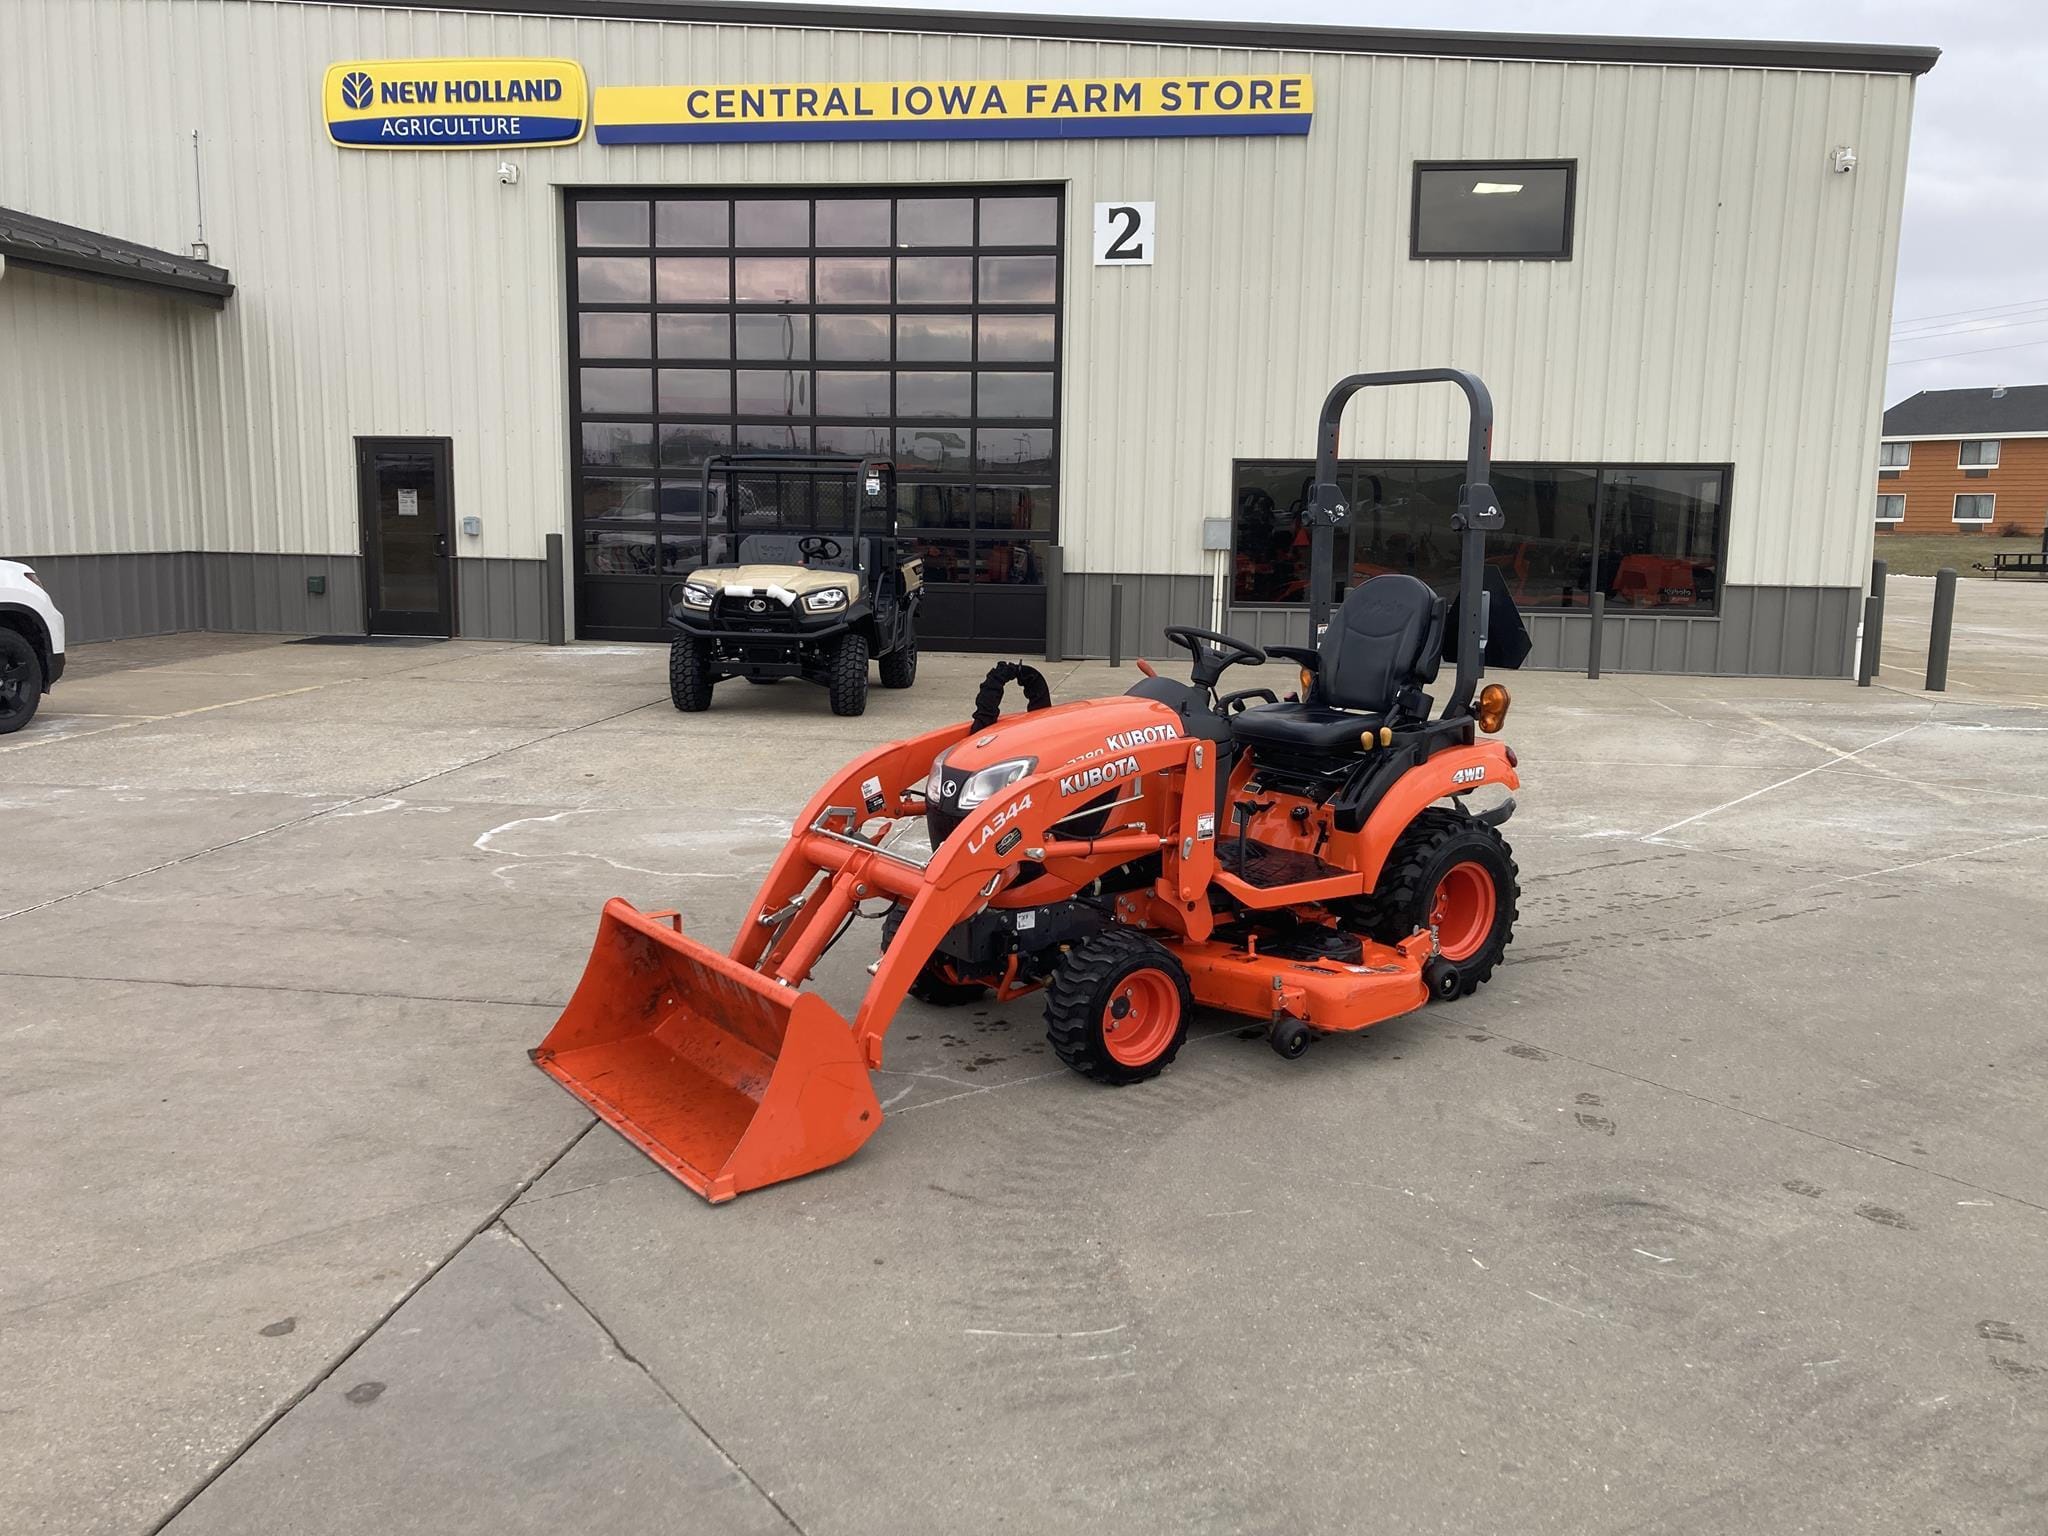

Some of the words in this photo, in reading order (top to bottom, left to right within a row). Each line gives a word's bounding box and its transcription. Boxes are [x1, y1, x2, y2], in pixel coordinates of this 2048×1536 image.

[381, 80, 437, 103] NEW
[445, 78, 562, 102] HOLLAND
[687, 84, 874, 118] CENTRAL
[893, 84, 1008, 115] IOWA
[1027, 82, 1142, 113] FARM
[1161, 80, 1302, 111] STORE
[381, 117, 521, 136] AGRICULTURE
[1105, 207, 1143, 260] 2
[1106, 724, 1178, 752] KUBOTA
[1060, 756, 1141, 797] KUBOTA
[1452, 766, 1485, 784] 4WD
[968, 793, 1033, 855] LA344
